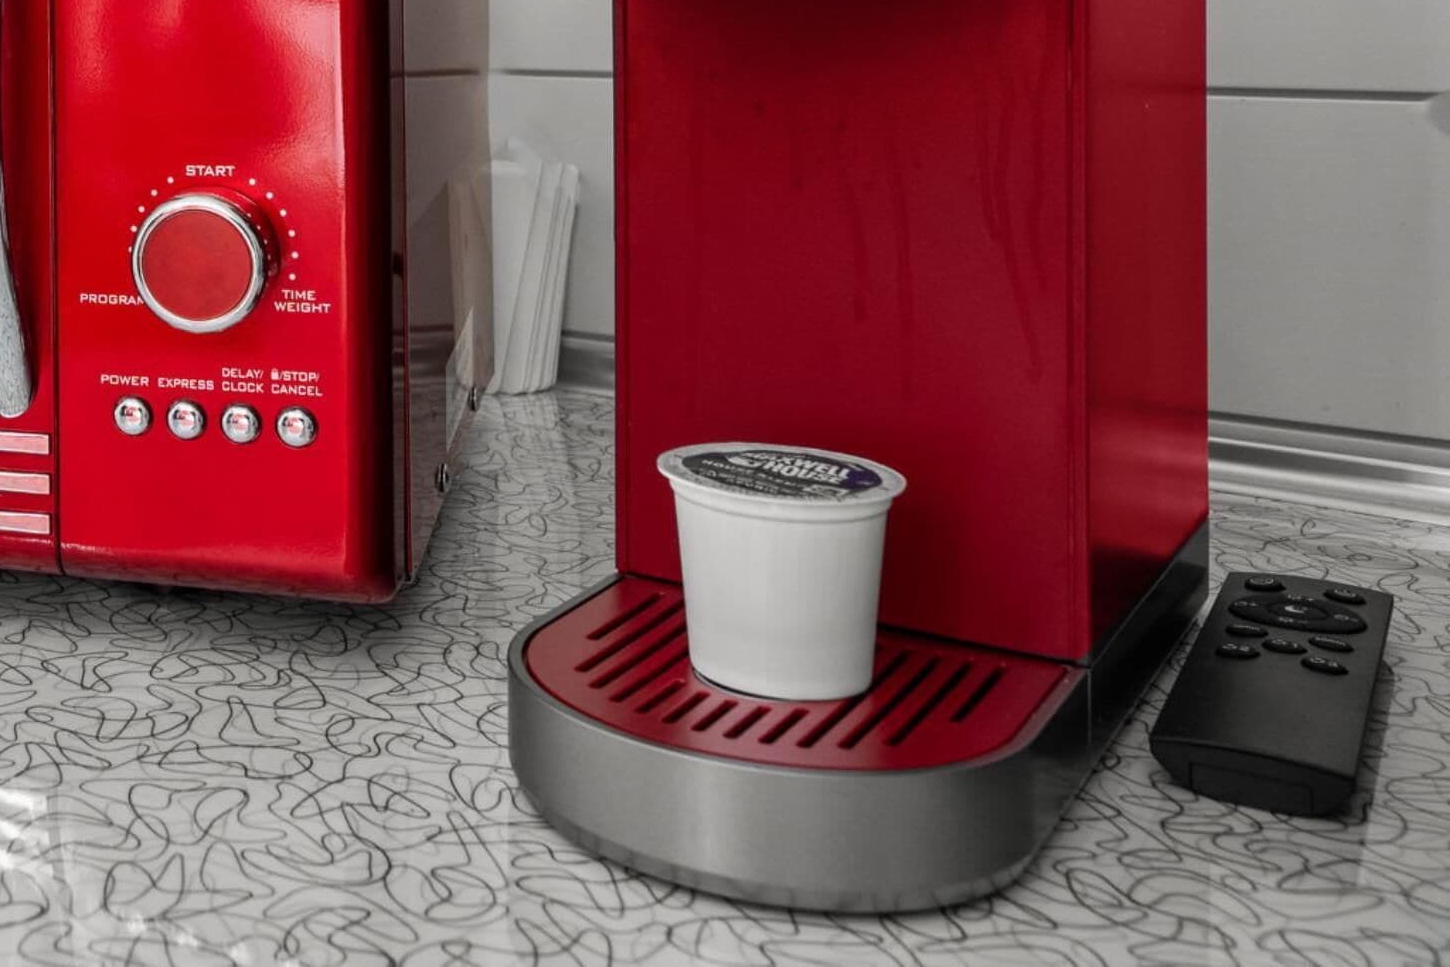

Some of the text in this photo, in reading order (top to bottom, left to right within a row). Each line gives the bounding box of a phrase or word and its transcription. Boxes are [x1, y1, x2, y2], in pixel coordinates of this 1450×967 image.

[185, 165, 236, 177] START
[282, 289, 316, 301] TIME
[274, 302, 331, 314] WEIGHT
[222, 367, 264, 380] DELAY/
[100, 374, 214, 390] POWER EXPRESS
[222, 381, 264, 394] CLOCK
[271, 384, 323, 397] CANCEL
